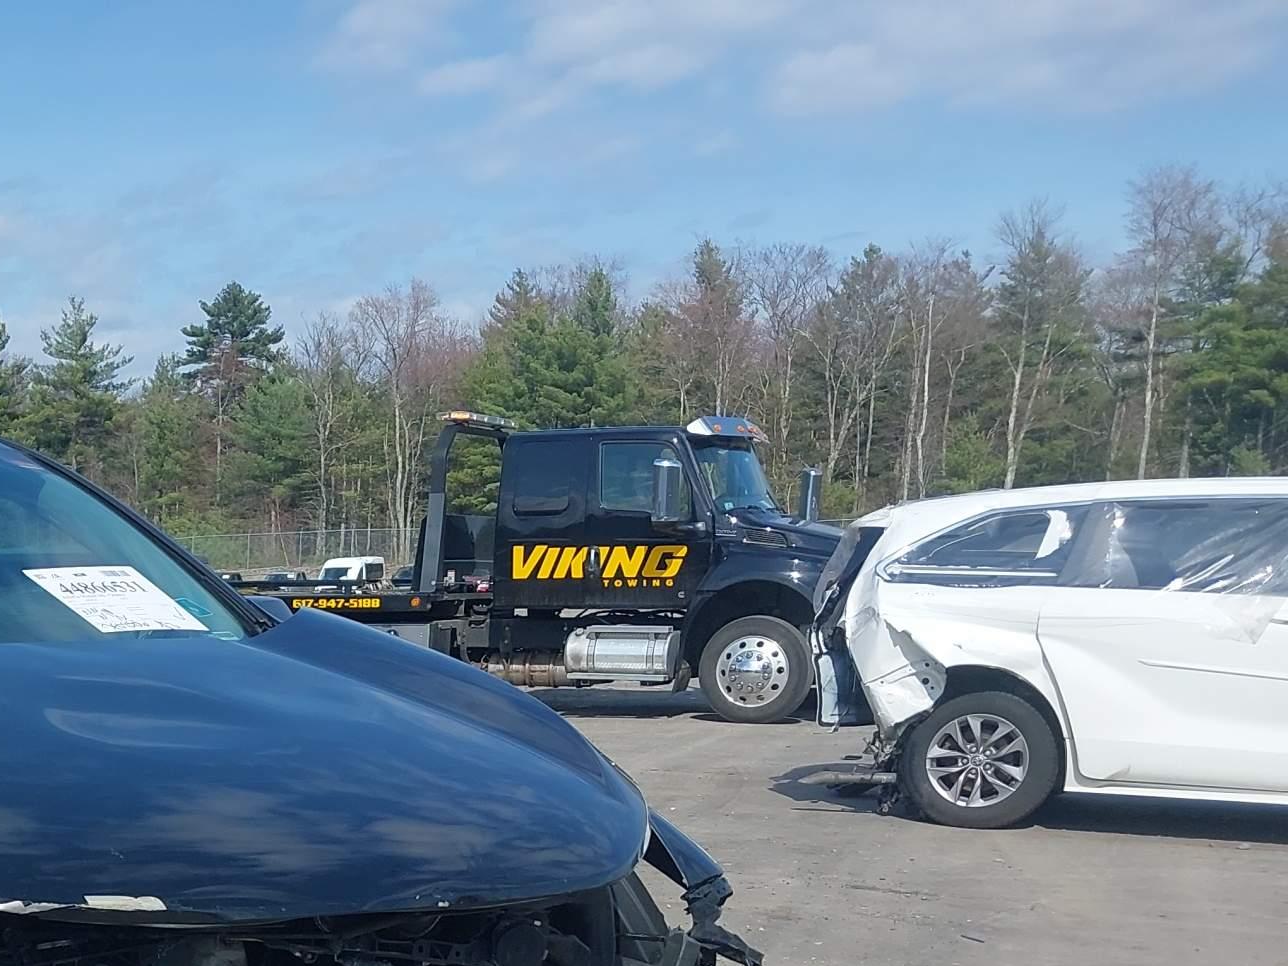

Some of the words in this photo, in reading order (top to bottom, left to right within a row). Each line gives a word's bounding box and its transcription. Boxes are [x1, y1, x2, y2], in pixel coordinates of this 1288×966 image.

[59, 580, 149, 595] 44866531
[602, 578, 675, 588] TOWING
[292, 598, 381, 609] 617-947-5188
